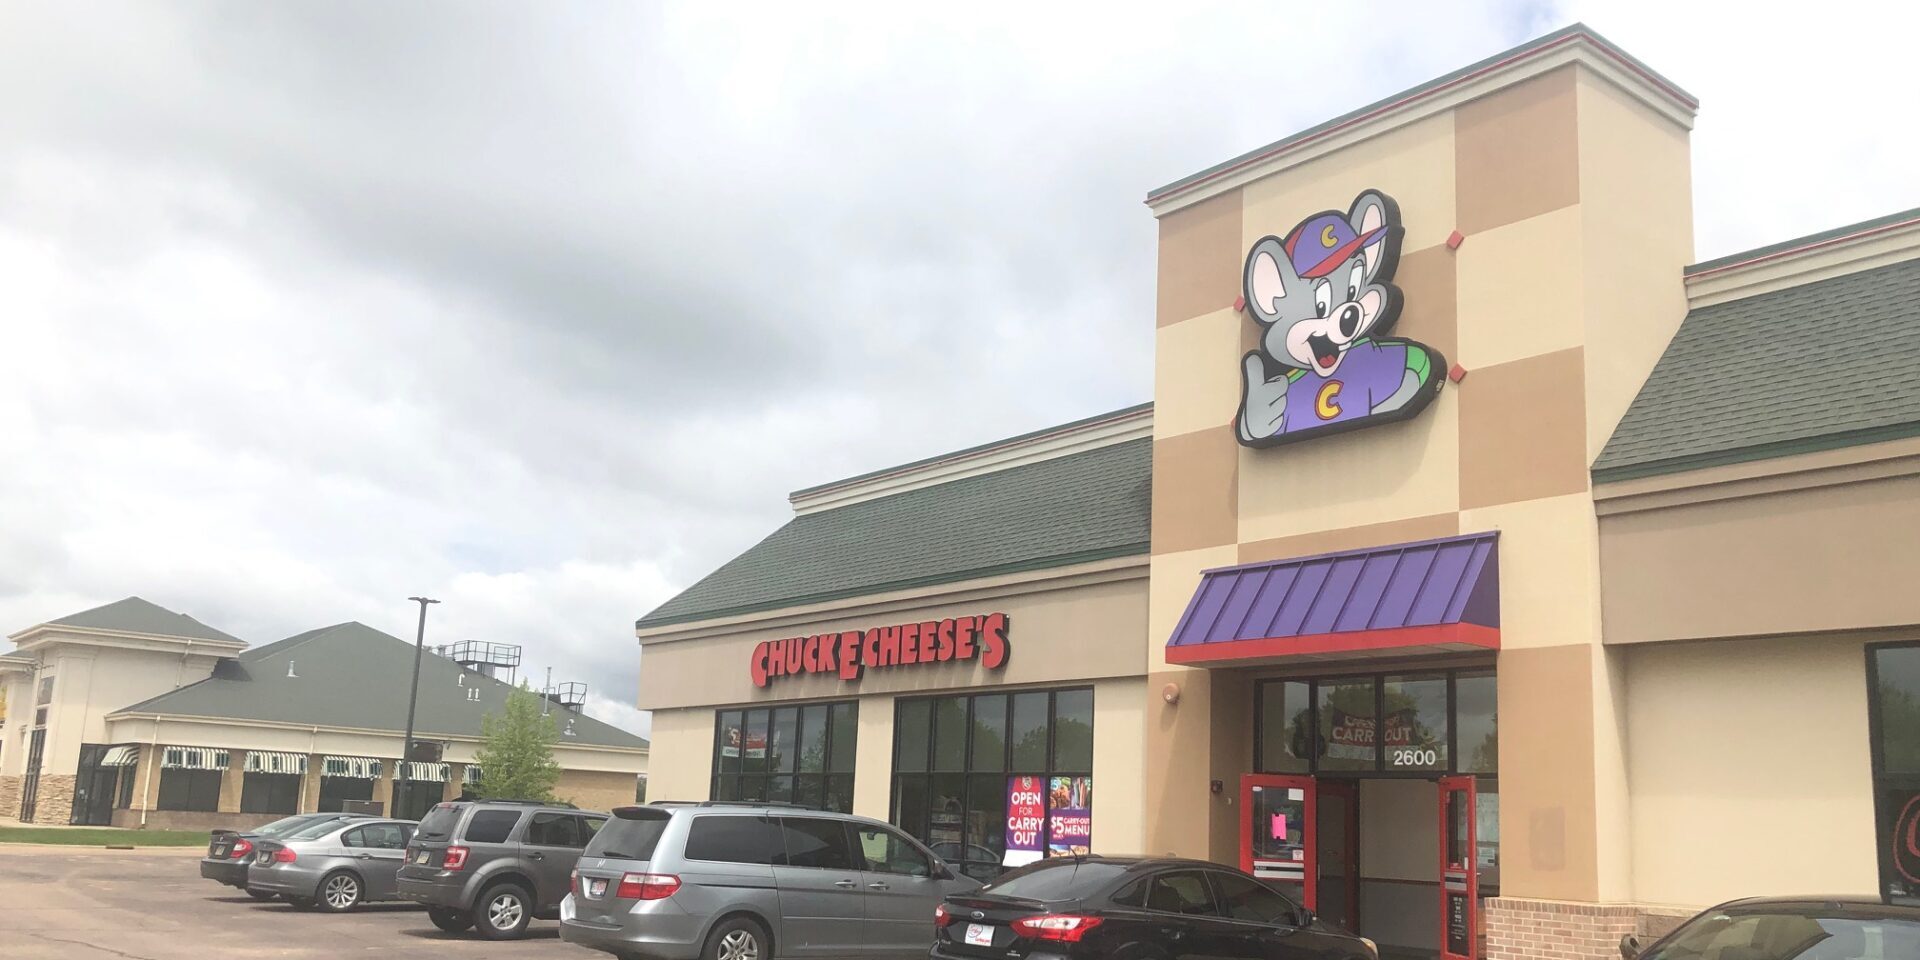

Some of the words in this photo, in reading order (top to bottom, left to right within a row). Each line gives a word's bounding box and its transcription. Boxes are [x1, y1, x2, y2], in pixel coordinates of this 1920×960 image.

[1314, 378, 1345, 421] C
[751, 633, 837, 688] CHUCK
[839, 631, 861, 680] E
[862, 612, 1007, 670] CHEESE'S
[1332, 726, 1375, 743] CARR
[1393, 750, 1436, 766] 2600
[1011, 791, 1041, 805] OPEN
[1018, 806, 1032, 816] FOR
[1008, 817, 1045, 832] CARRY
[1051, 816, 1065, 834] $5
[1064, 825, 1090, 836] MENU
[1013, 832, 1037, 846] OUT
